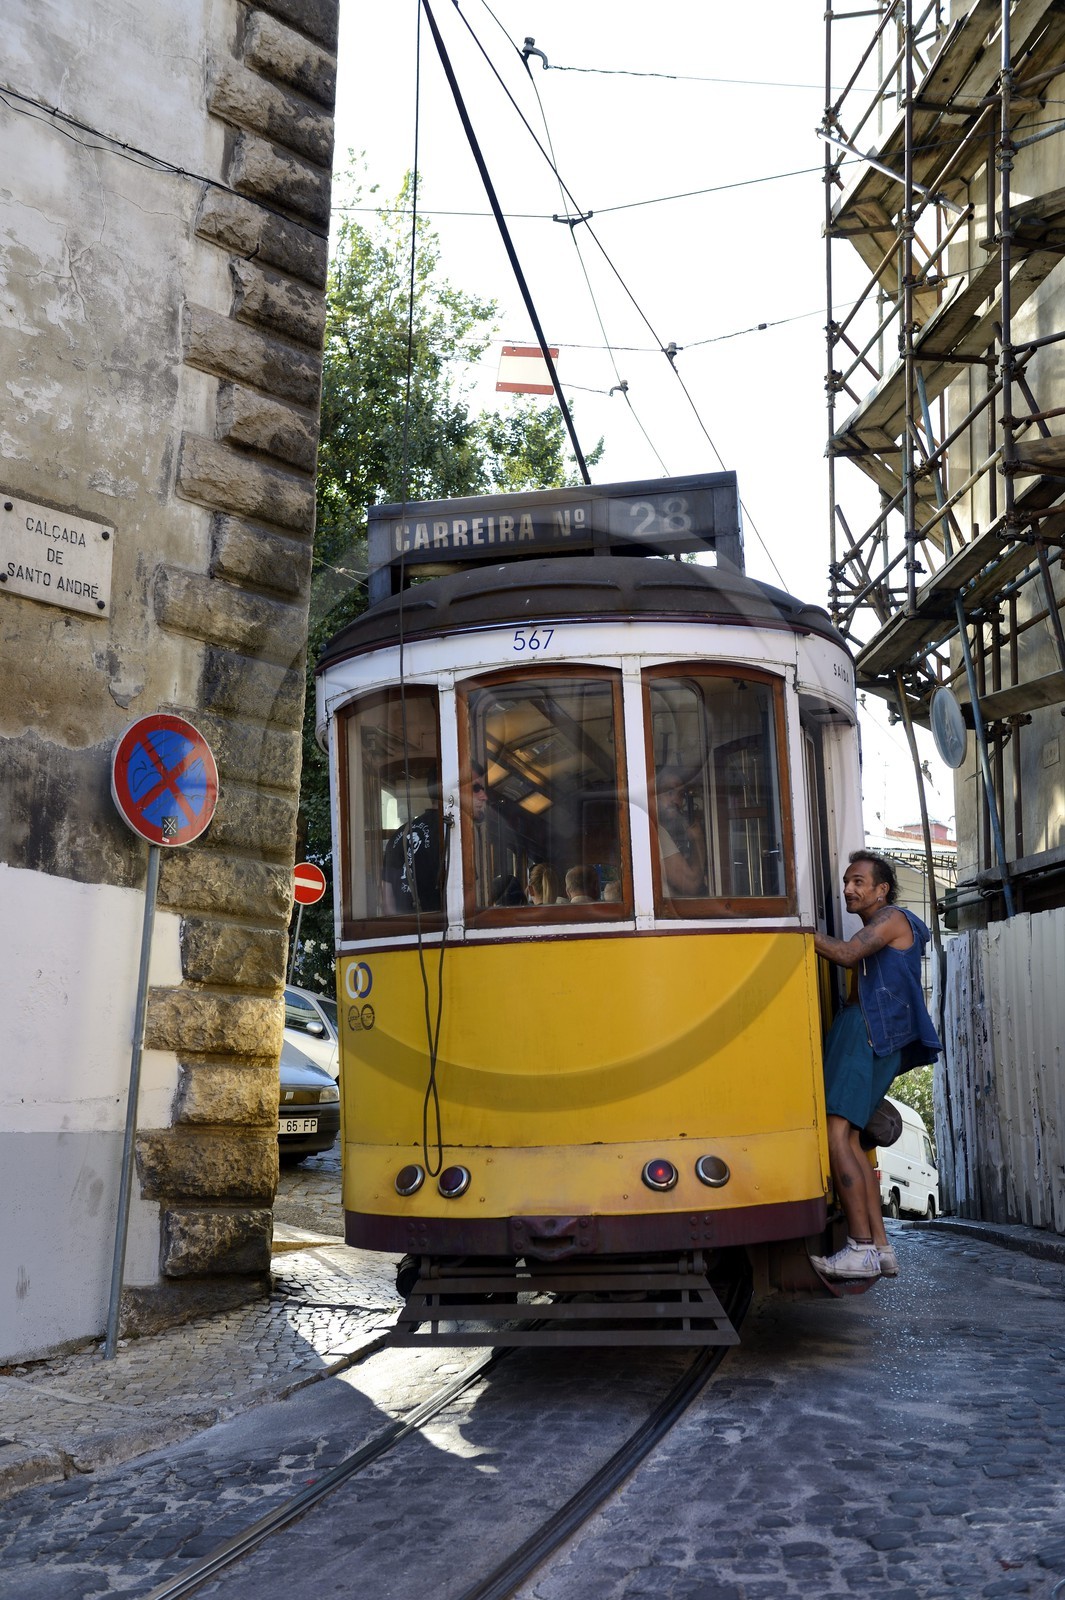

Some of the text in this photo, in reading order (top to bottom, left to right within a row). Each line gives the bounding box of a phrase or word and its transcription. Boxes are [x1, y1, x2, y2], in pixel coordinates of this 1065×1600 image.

[25, 517, 86, 548] CALÇADA
[395, 513, 535, 551] CARREIRA
[630, 497, 692, 537] 28
[47, 547, 64, 566] DE
[7, 562, 99, 600] SANTO ANDRÉ
[513, 629, 554, 651] 567
